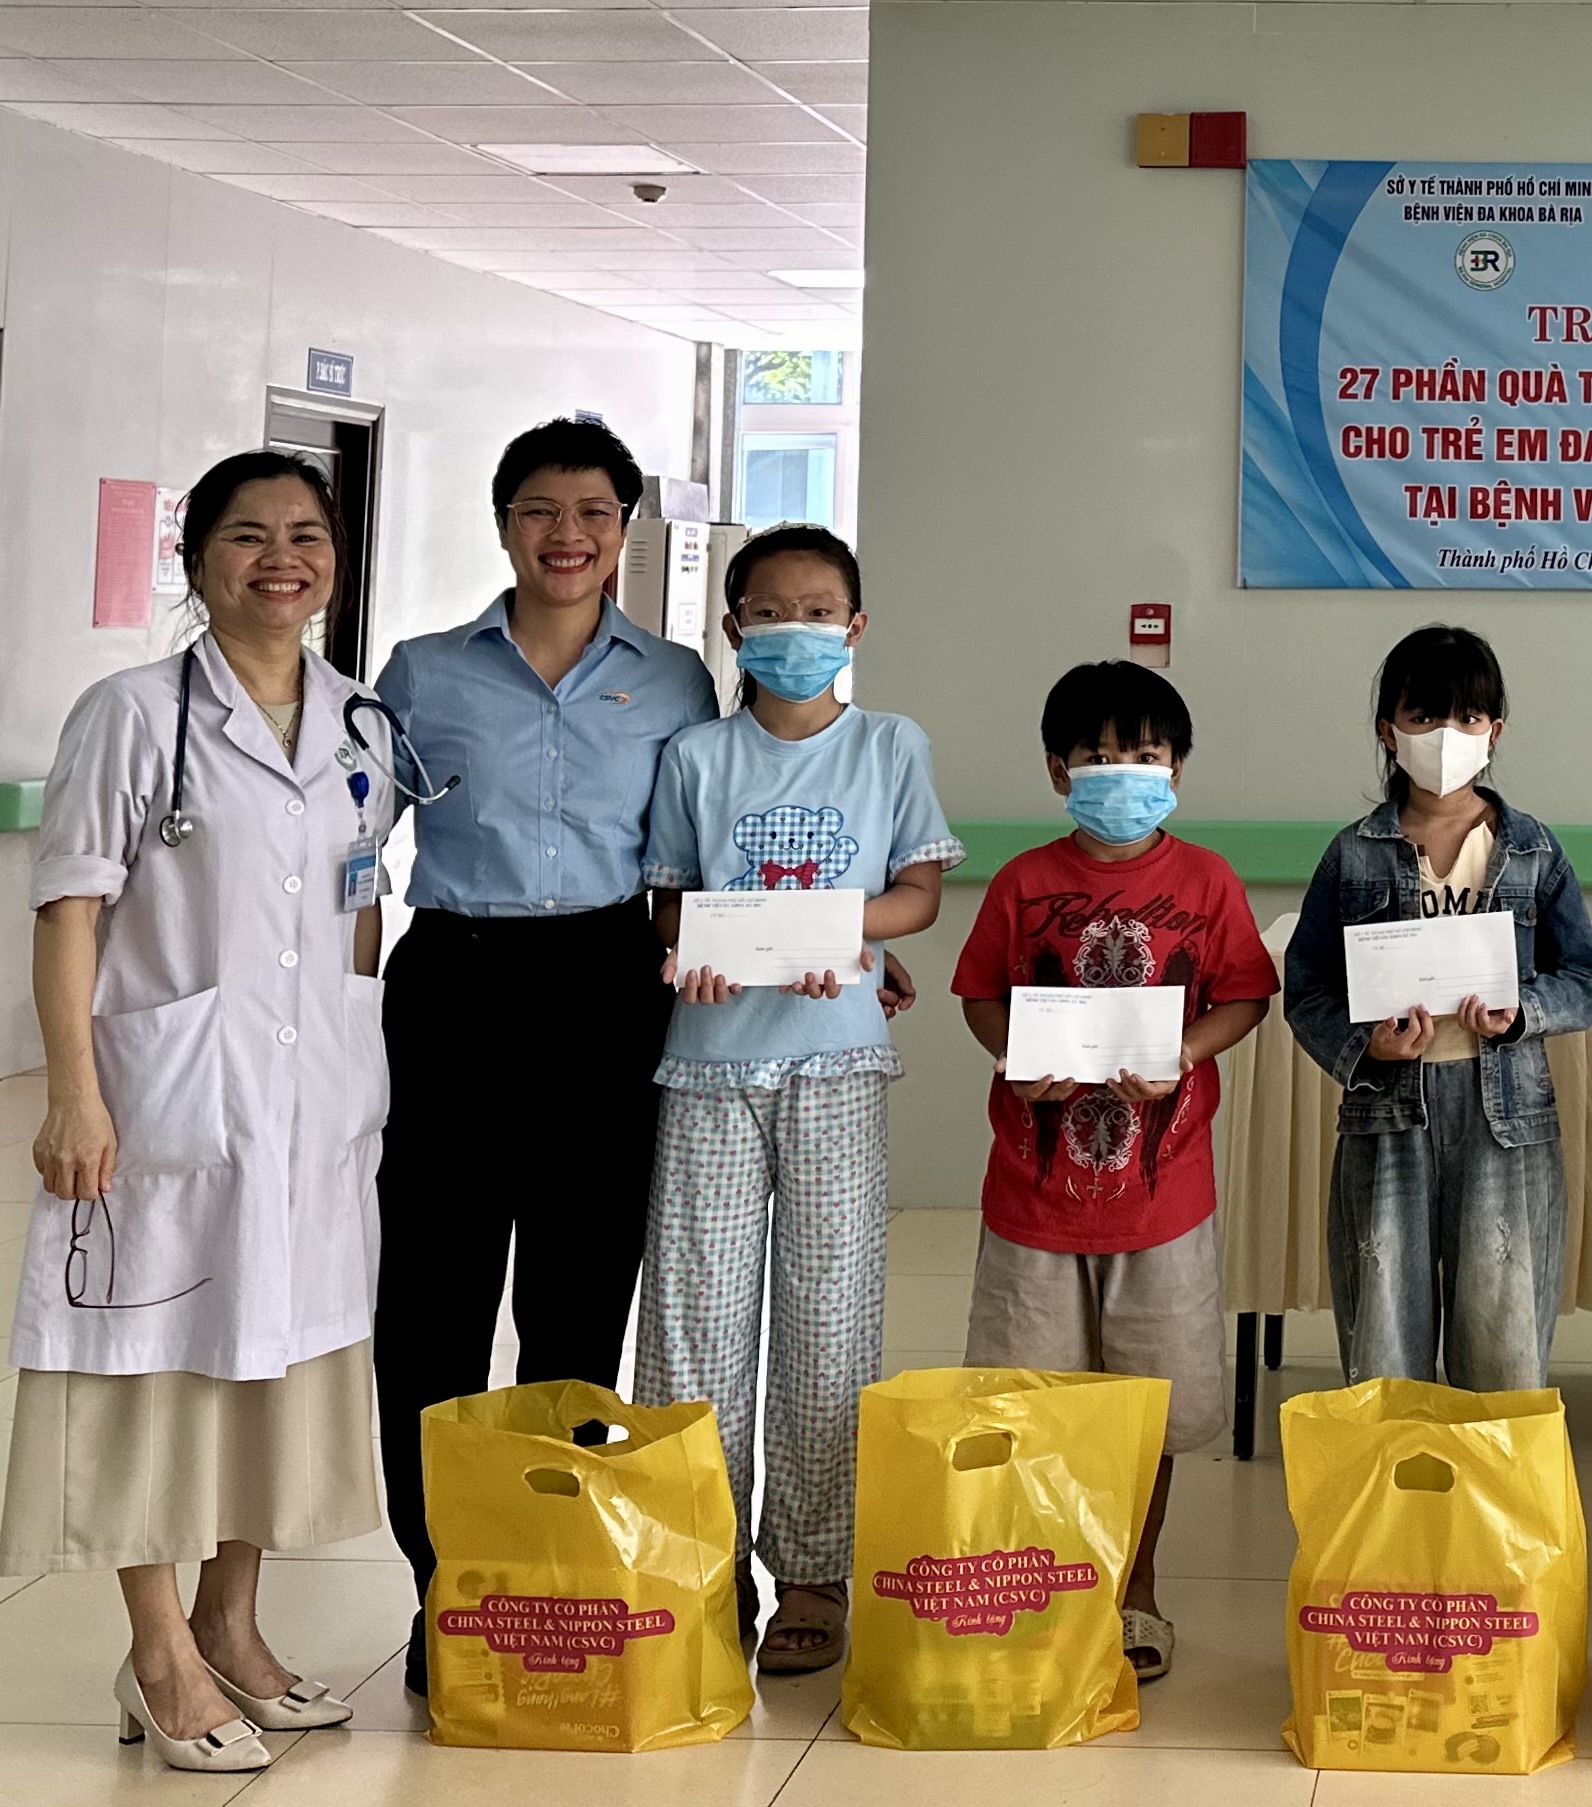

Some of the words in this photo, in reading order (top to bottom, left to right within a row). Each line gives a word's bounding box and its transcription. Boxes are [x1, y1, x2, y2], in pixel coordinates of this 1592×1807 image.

[1407, 180, 1417, 195] Y
[1421, 176, 1436, 195] TẾ
[1439, 177, 1483, 196] THÀNH
[1487, 176, 1513, 196] PHỐ
[1539, 178, 1561, 196] CHÍ
[1404, 203, 1440, 224] BỆNH
[1443, 203, 1473, 225] VIỆN
[1477, 206, 1495, 222] ĐA
[1500, 207, 1534, 222] KHOA
[1539, 204, 1556, 222] BÀ
[1560, 207, 1583, 225] RỊA
[1338, 367, 1380, 400] 27
[1392, 357, 1486, 401] PHẦN
[1498, 364, 1568, 406] QUÀ
[1341, 426, 1410, 458] CHO
[1422, 416, 1483, 460] TRẺ
[1496, 428, 1548, 462] EM
[1404, 485, 1457, 526] TẠI
[1469, 479, 1562, 527] BỆNH
[1439, 549, 1496, 569] Thành
[1500, 545, 1536, 573] phố
[1540, 546, 1568, 569] Hồ
[908, 1561, 953, 1577] CÔNG
[957, 1562, 978, 1575] TY
[873, 1575, 913, 1593] CHINA
[916, 1580, 965, 1594] STEEL
[968, 1579, 980, 1590] &
[984, 1572, 1043, 1589] NIPPON
[1047, 1568, 1097, 1584] STEEL
[488, 1598, 530, 1613] CÔNG
[533, 1602, 551, 1614] TY
[913, 1597, 949, 1614] VIỆT
[953, 1593, 989, 1609] NAM
[993, 1589, 1046, 1607] (CSVC)
[1350, 1594, 1394, 1610] CÔNG
[1398, 1598, 1418, 1611] TY
[447, 1615, 494, 1629] CHINA
[496, 1617, 542, 1630] STEEL
[544, 1619, 555, 1630] &
[559, 1619, 612, 1632] NIPPON
[616, 1615, 666, 1632] STEEL
[1307, 1612, 1355, 1627] CHINA
[1358, 1615, 1406, 1629] STEEL
[1409, 1616, 1421, 1629] &
[1425, 1617, 1481, 1631] NIPPON
[1484, 1616, 1532, 1630] STEEL
[493, 1632, 527, 1649] VIỆT
[531, 1635, 563, 1648] NAM
[567, 1636, 616, 1651] (CSVC)
[1355, 1631, 1389, 1647] VIỆT
[1394, 1633, 1429, 1646] NAM
[1433, 1635, 1483, 1649] (CSVC)
